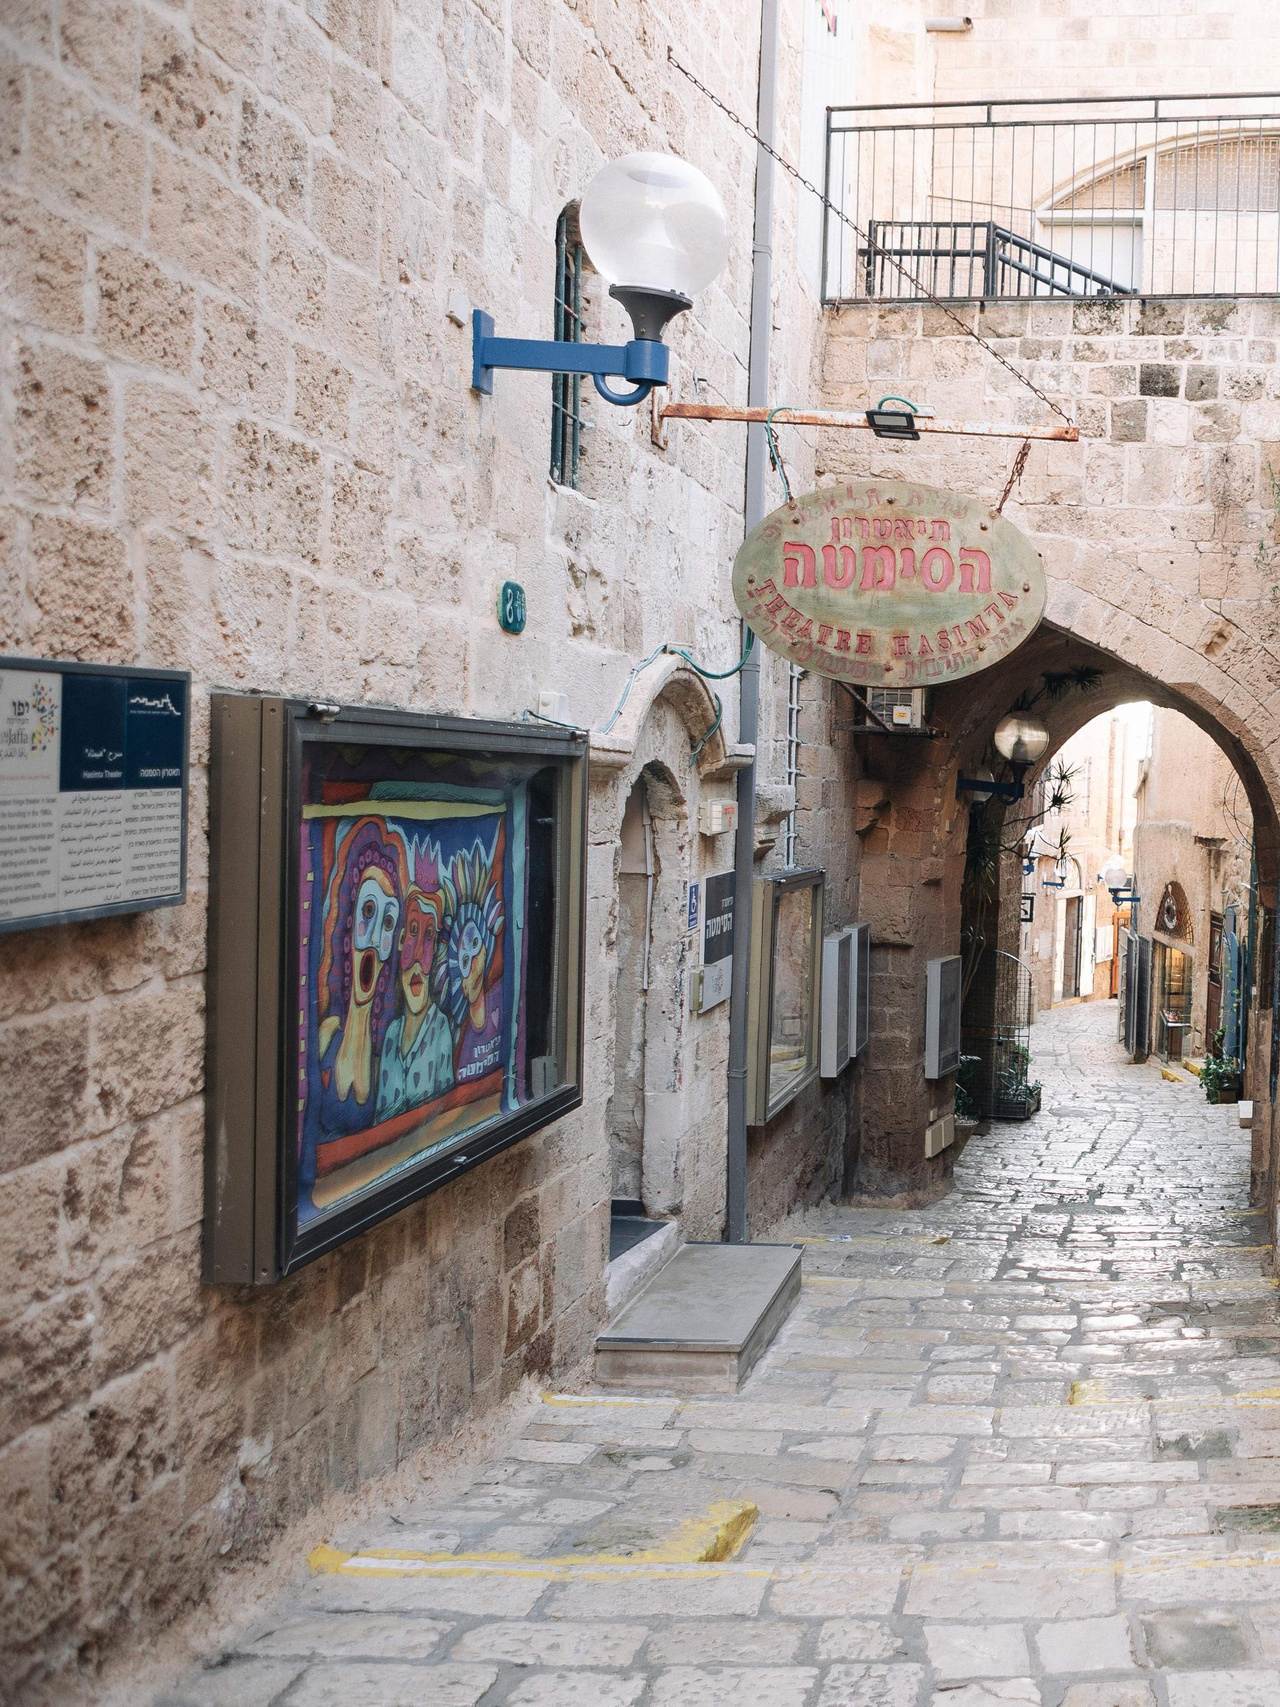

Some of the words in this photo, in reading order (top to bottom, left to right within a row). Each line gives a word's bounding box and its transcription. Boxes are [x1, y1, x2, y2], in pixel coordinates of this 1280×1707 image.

[830, 516, 951, 543] תיאטרון
[782, 541, 992, 594] הסימטה
[506, 588, 514, 624] 8
[754, 578, 872, 656] THEATRE
[892, 591, 1019, 656] HASIMTA
[12, 700, 29, 716] יפו
[8, 727, 29, 746] Jaffa
[706, 912, 733, 939] הסימטה
[457, 1050, 500, 1081] הסימטה
